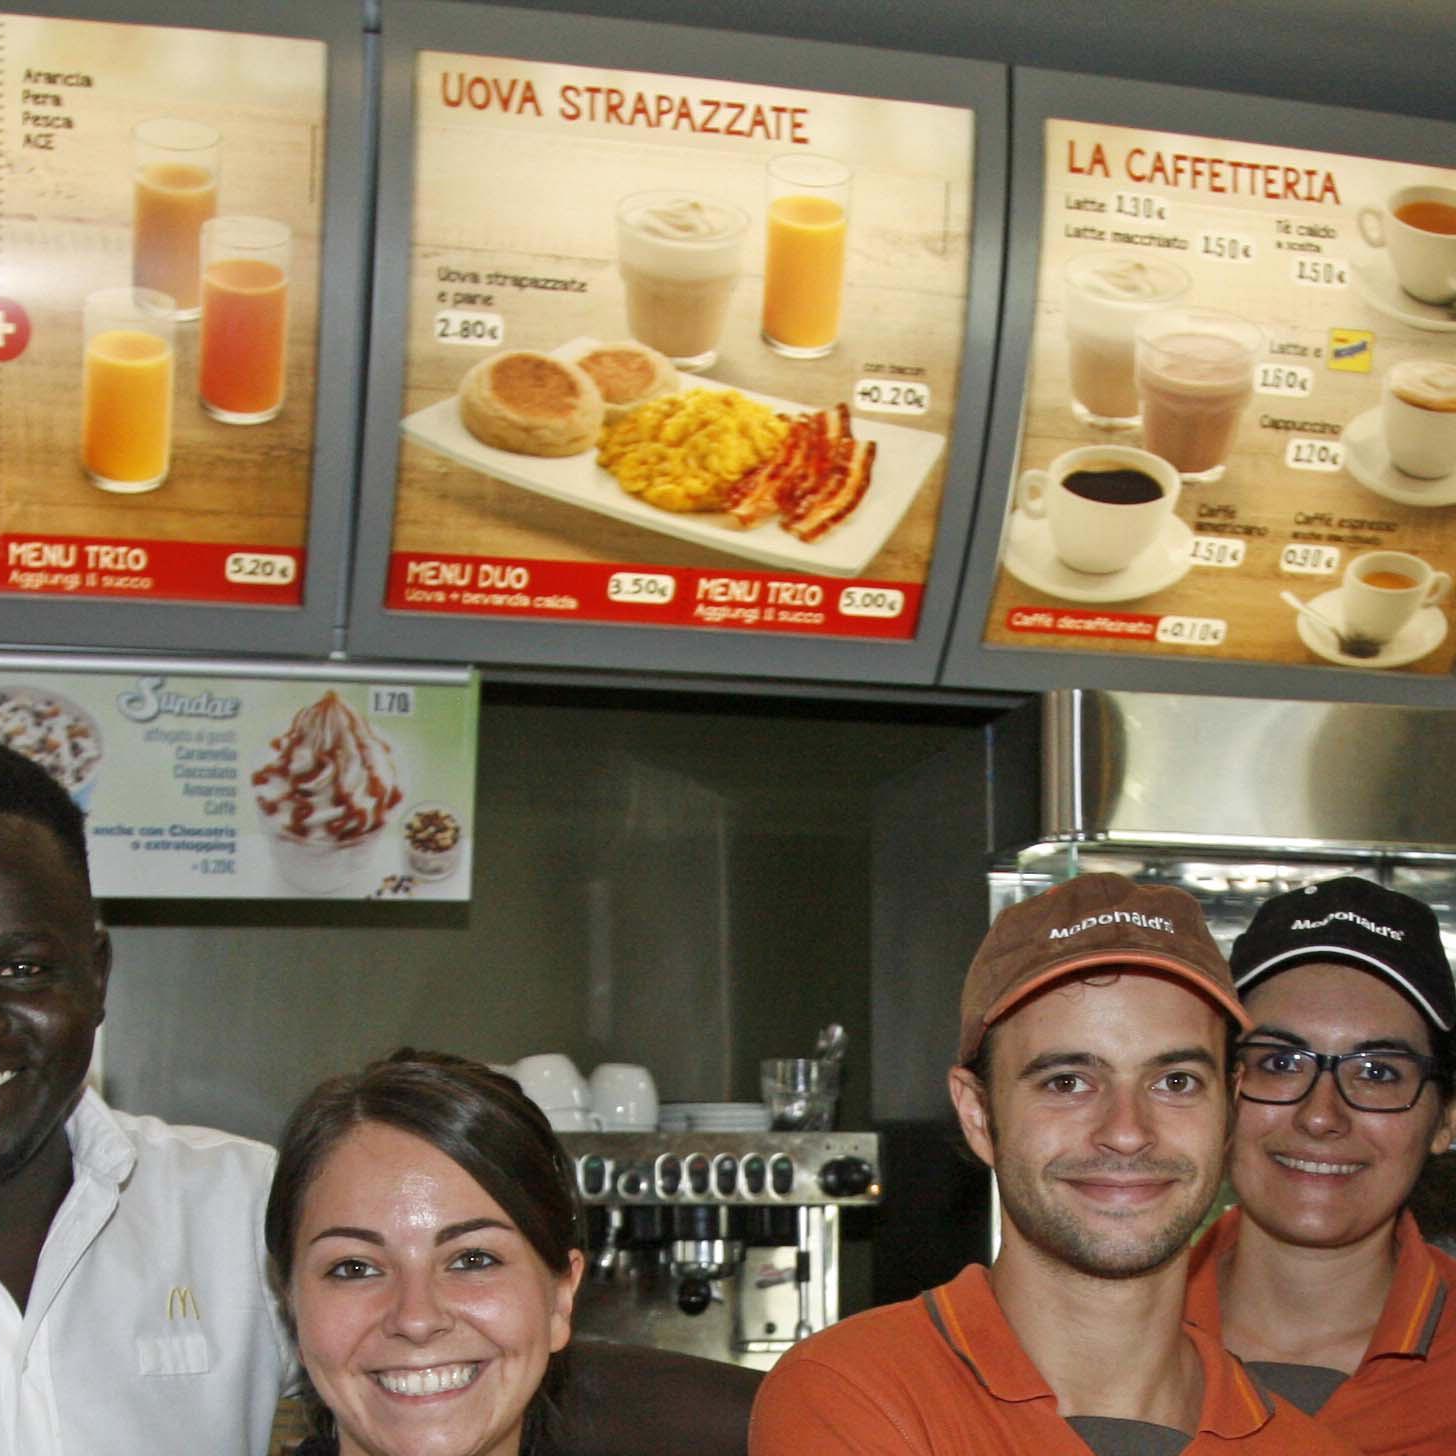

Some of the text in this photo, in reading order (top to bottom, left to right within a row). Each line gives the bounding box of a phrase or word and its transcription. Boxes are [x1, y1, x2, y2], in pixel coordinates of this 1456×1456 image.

[22, 68, 94, 89] Arancia
[21, 89, 64, 108] Pera
[440, 71, 811, 145] UOVA STRAPAZZATE
[21, 111, 75, 130] Pesca
[22, 133, 57, 152] ACE
[1066, 139, 1341, 206] LA CAFFETTERIA
[1065, 195, 1108, 213] Latte
[1065, 223, 1106, 242] Latte
[437, 266, 482, 286] Uova
[1259, 414, 1342, 435] Cappuccino
[8, 541, 148, 572] MENU TRIO
[406, 559, 529, 590] MENU DUO
[696, 576, 823, 607] MENU TRIO
[1047, 909, 1176, 940] McDonald's
[1290, 910, 1406, 941] McDonald's
